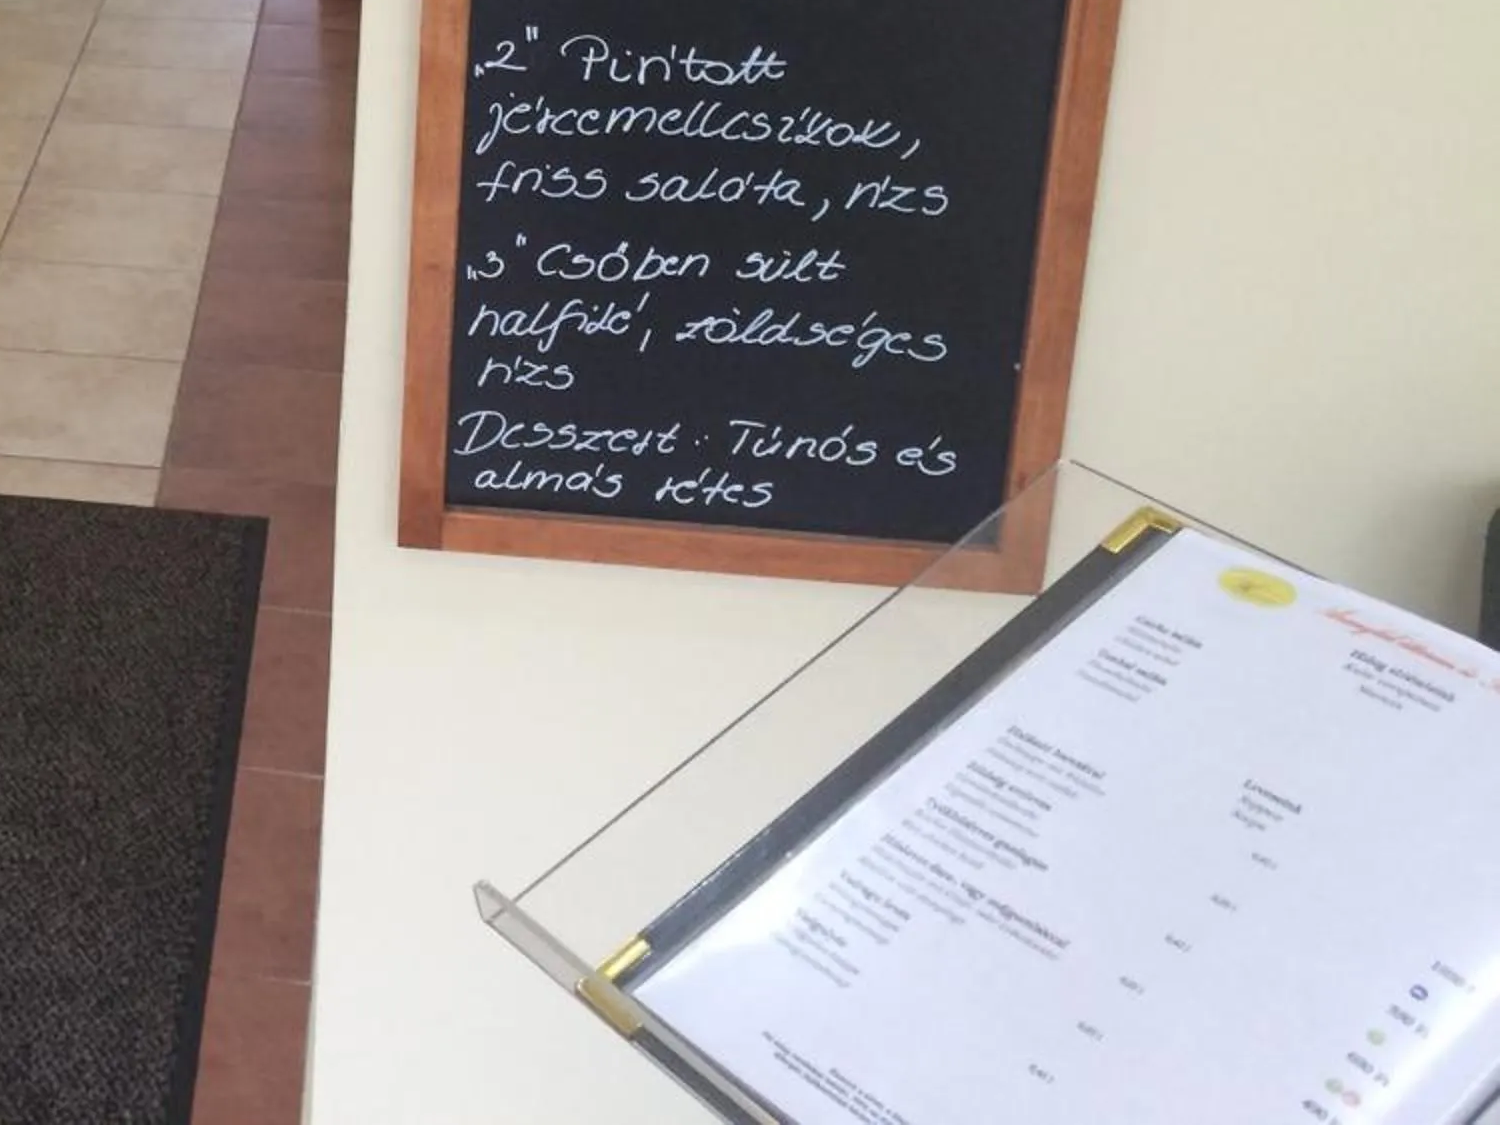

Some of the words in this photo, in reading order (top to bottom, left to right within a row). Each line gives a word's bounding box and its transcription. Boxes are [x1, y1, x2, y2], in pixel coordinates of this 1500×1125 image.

[477, 161, 606, 201] friss
[626, 168, 829, 221] saláta,
[897, 437, 956, 475] és
[475, 461, 622, 497] almás
[656, 466, 774, 507] rétes
